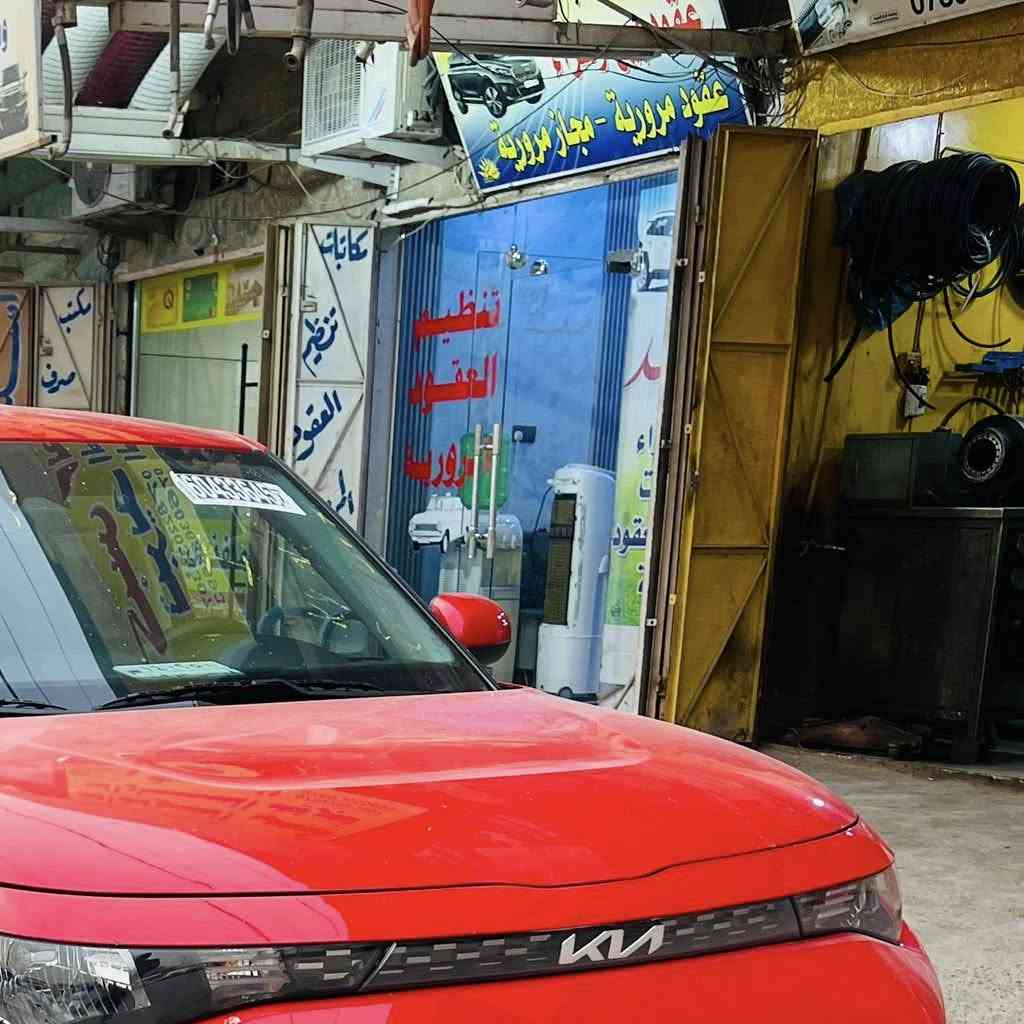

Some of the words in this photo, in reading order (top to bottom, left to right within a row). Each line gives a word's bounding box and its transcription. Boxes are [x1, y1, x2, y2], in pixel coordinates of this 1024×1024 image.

[603, 89, 678, 147] مرورية
[678, 69, 730, 129] عقود
[488, 118, 553, 173] مرورية
[412, 288, 502, 352] تنظيم
[406, 351, 500, 417] العقود
